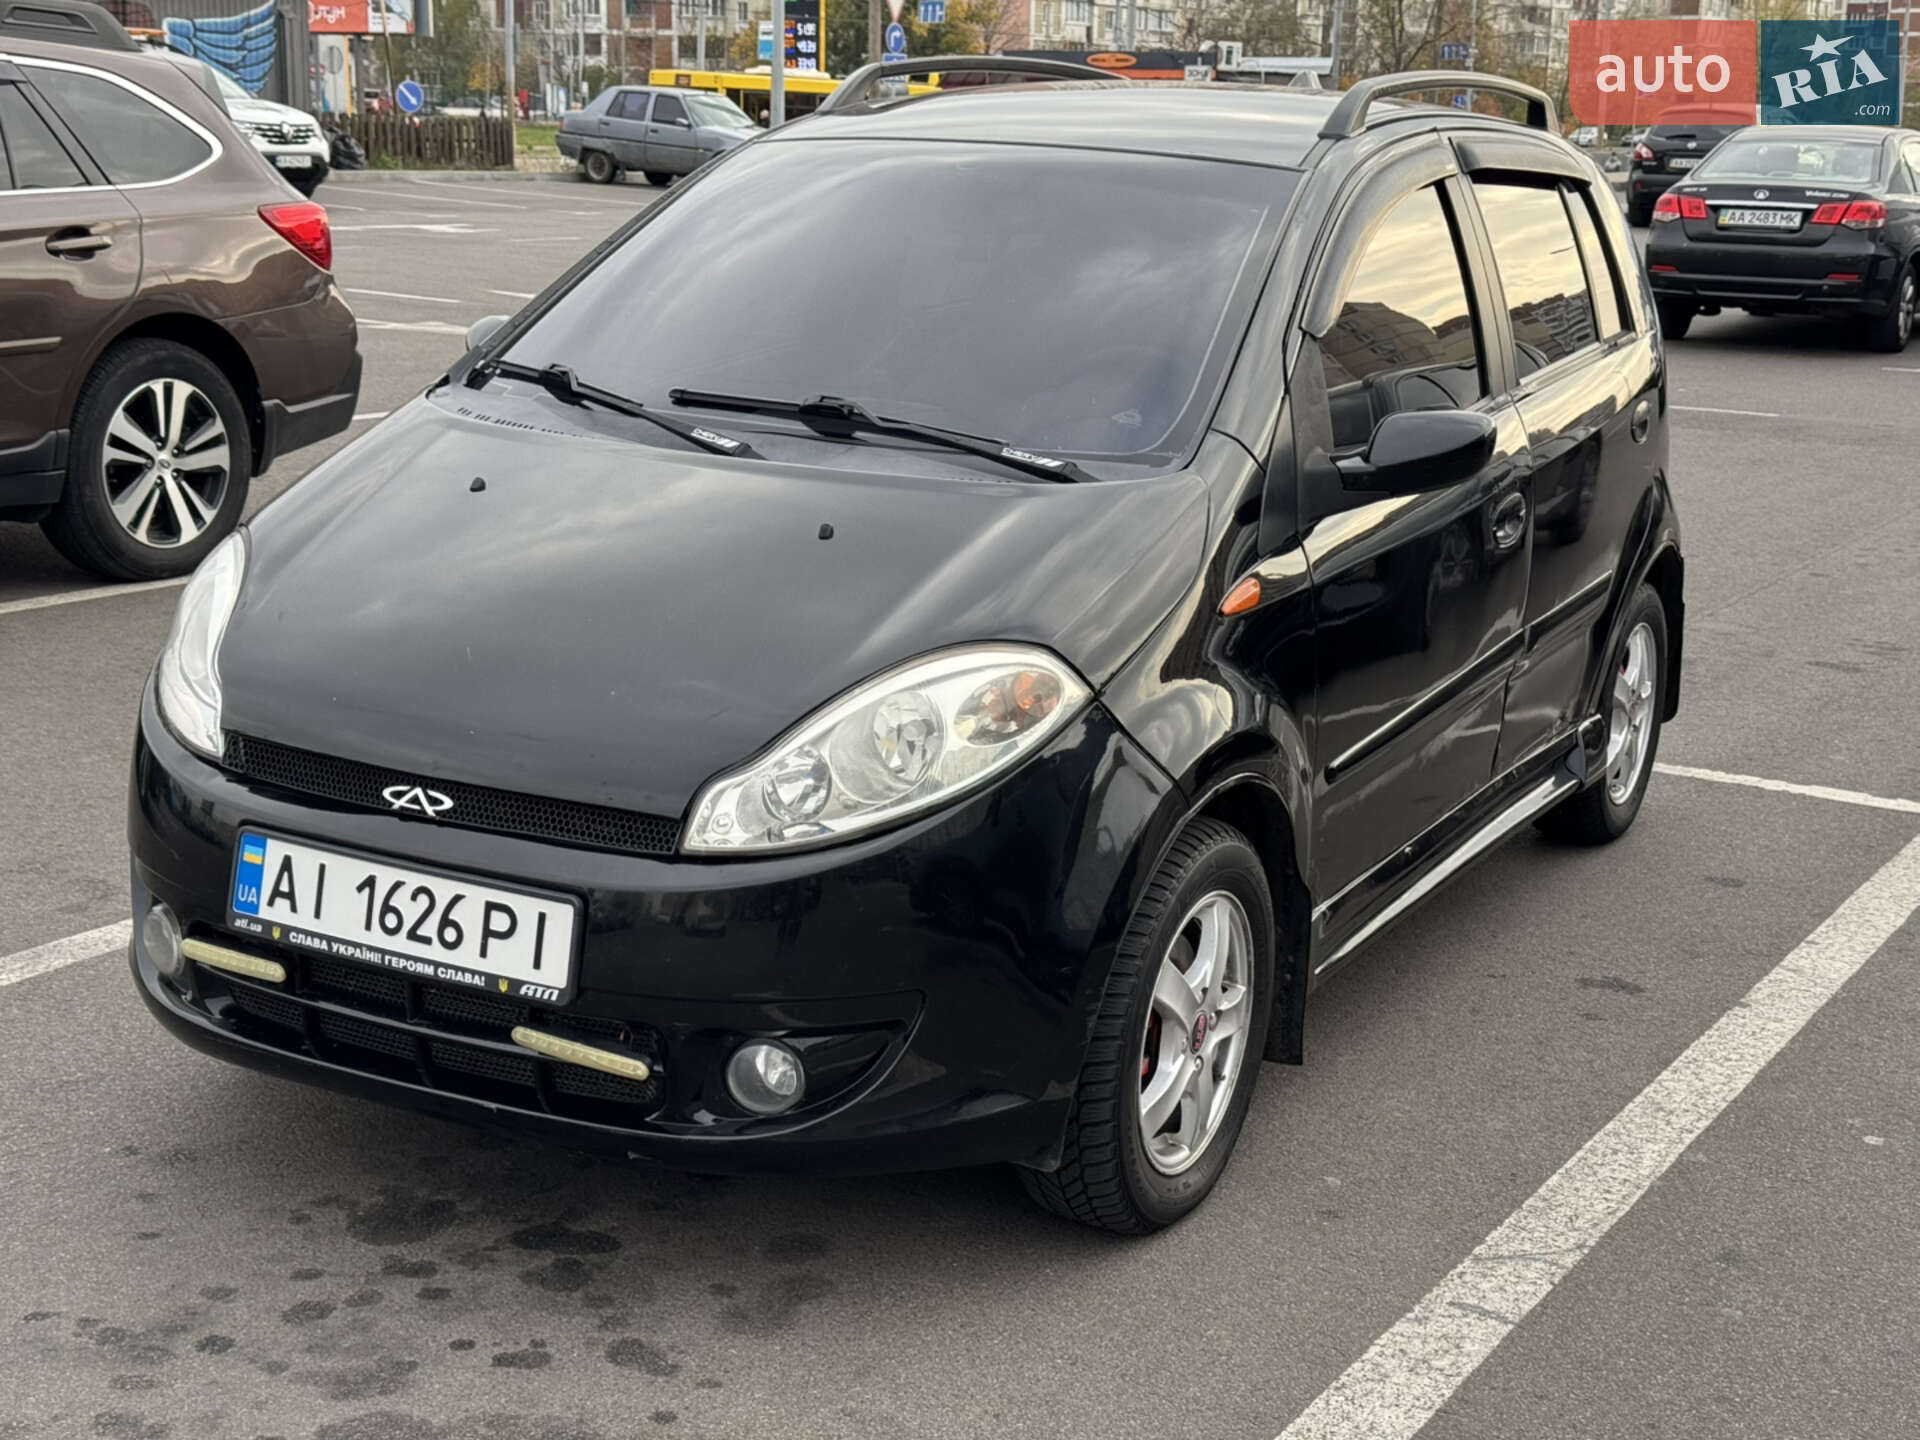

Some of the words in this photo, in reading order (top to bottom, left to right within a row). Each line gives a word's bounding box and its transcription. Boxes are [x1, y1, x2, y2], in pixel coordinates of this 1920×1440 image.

[1728, 211, 1747, 223] AA
[1750, 212, 1777, 224] 2483
[1779, 214, 1798, 226] MK
[238, 884, 258, 905] UA
[355, 874, 467, 951] 1626
[289, 932, 329, 951] СЛАВА
[331, 942, 382, 964] УКРАЇНІ!
[384, 955, 434, 976] ГЕРОЯМ
[437, 967, 485, 987] СЛАВА!
